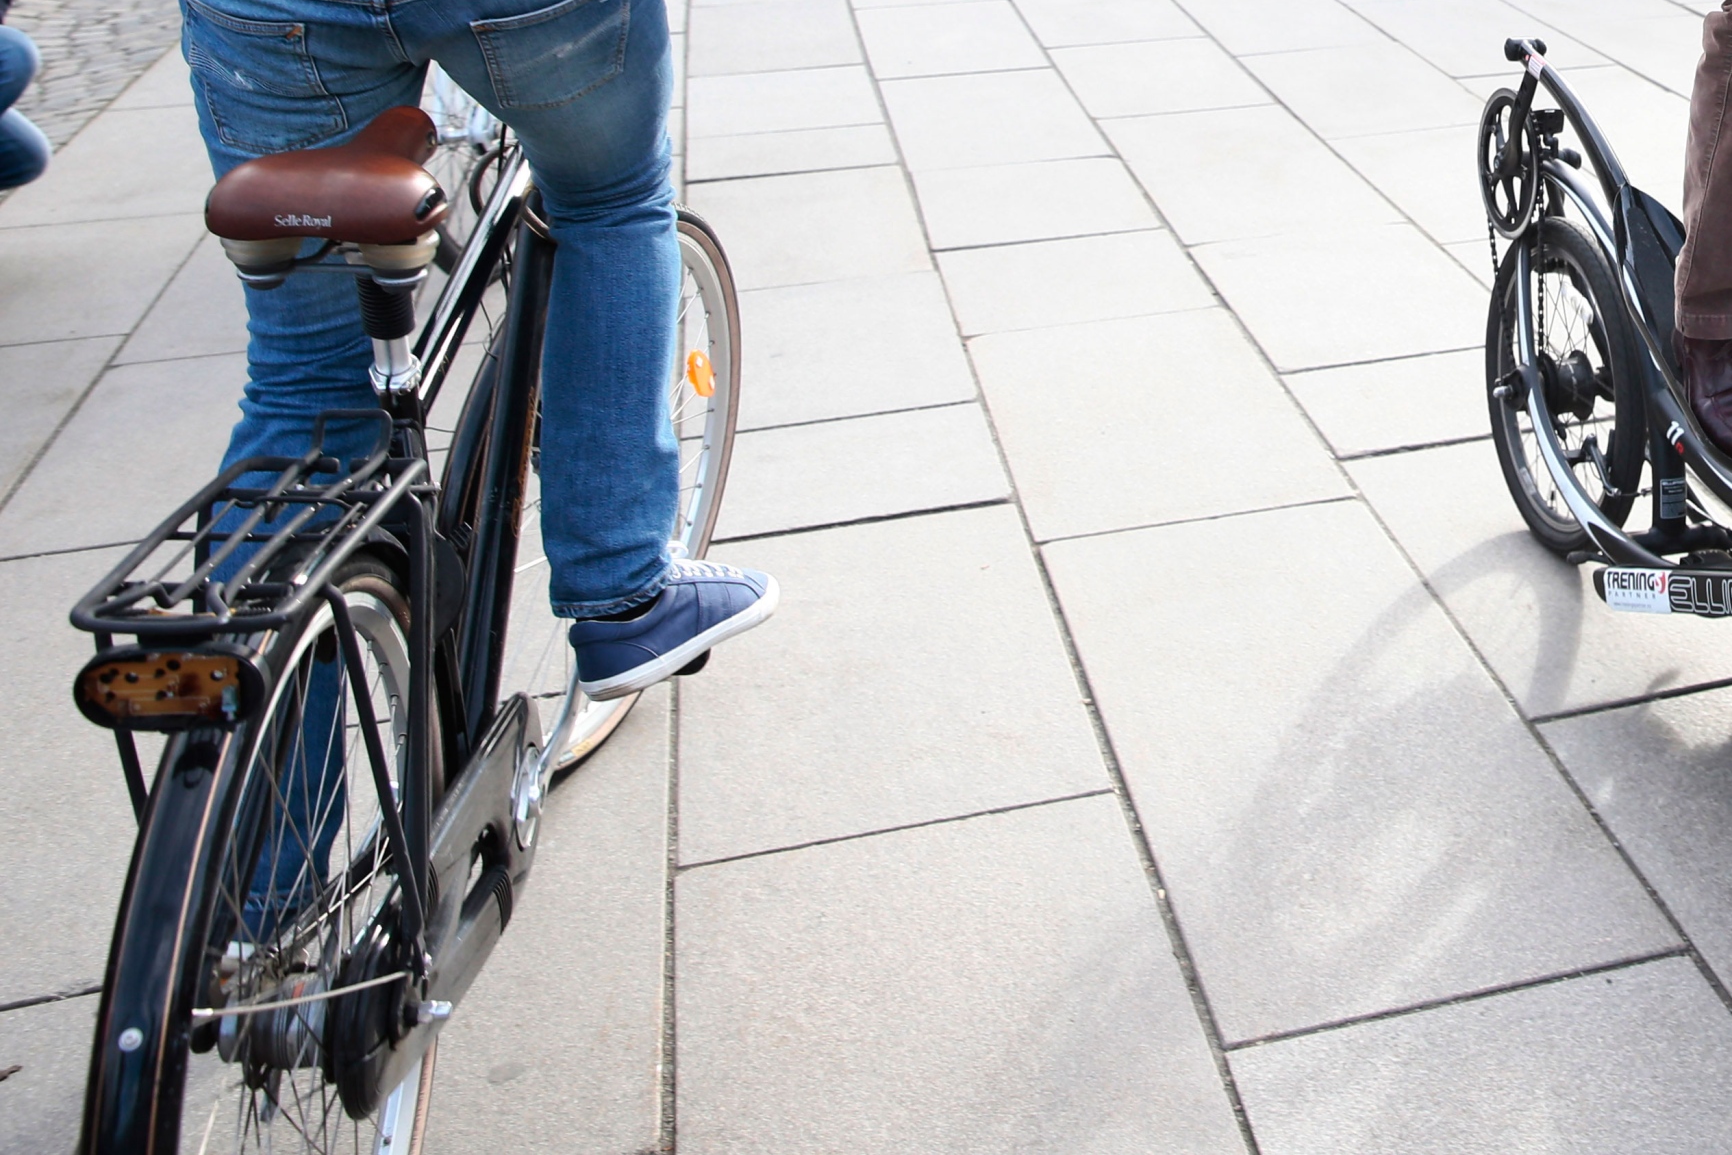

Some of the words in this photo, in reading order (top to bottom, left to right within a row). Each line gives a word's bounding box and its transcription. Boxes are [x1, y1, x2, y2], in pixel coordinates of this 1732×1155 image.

[274, 214, 302, 227] Selle
[302, 214, 332, 229] Royal
[1608, 590, 1656, 600] PARTNER
